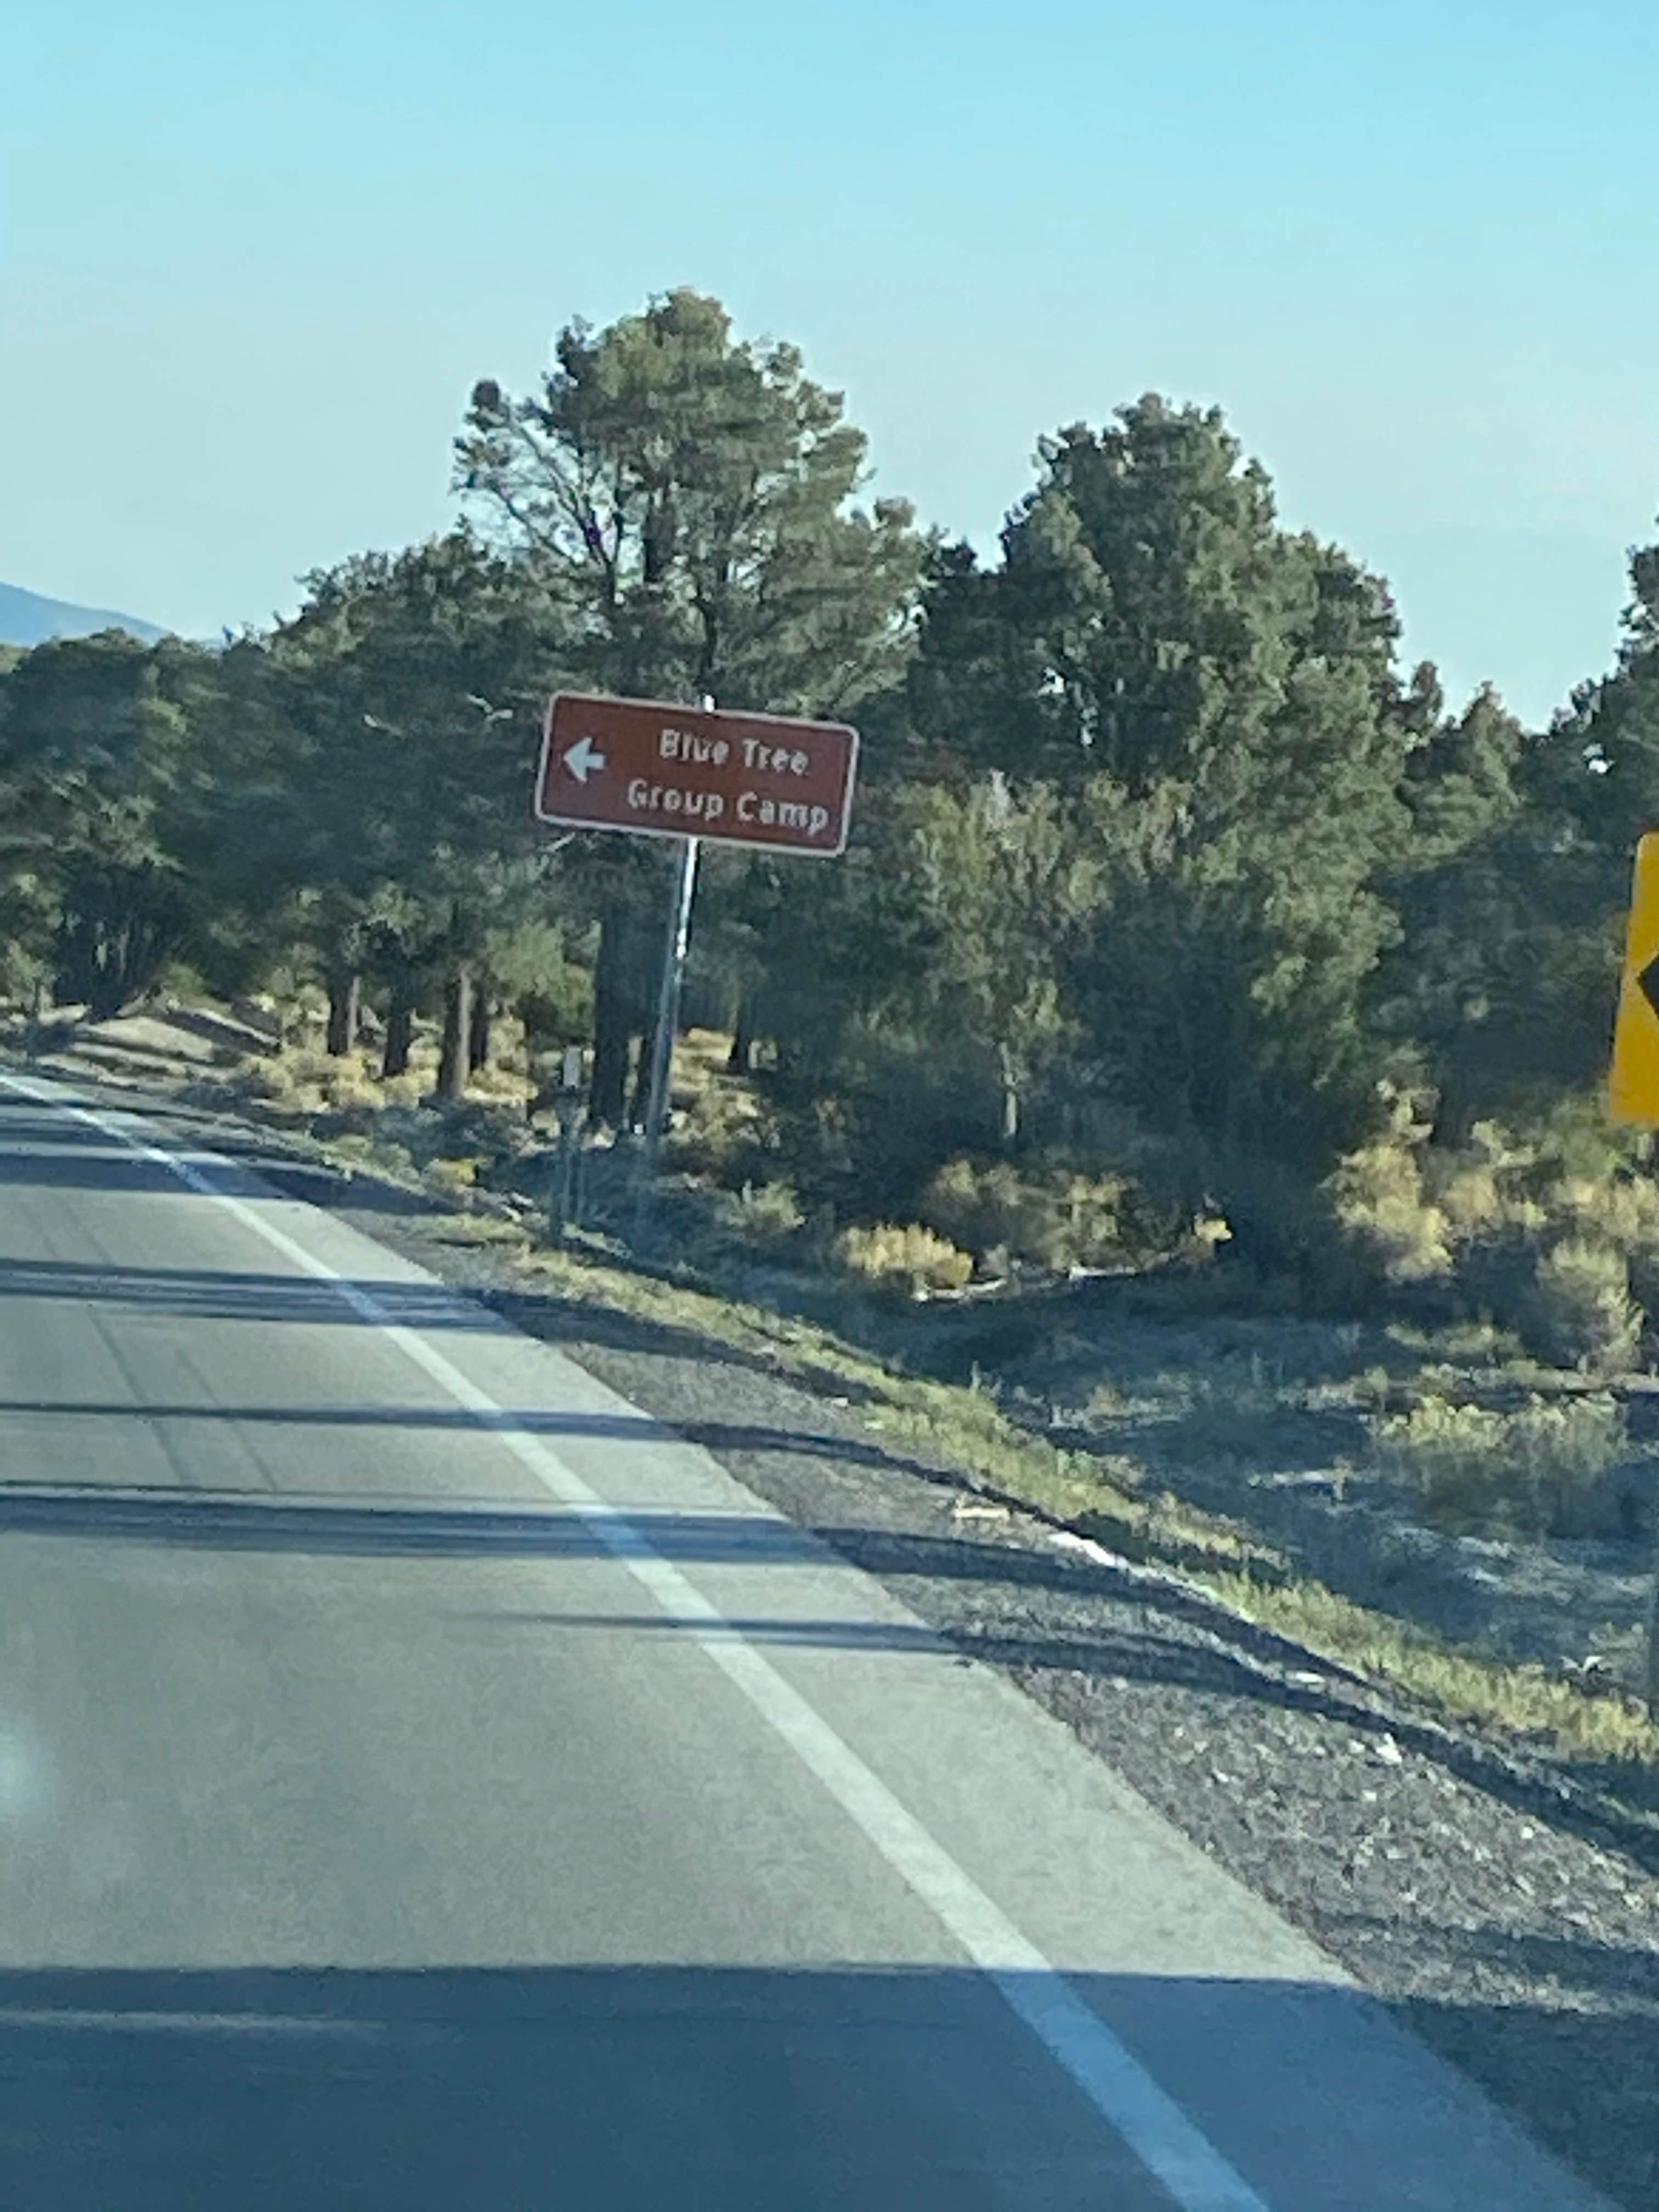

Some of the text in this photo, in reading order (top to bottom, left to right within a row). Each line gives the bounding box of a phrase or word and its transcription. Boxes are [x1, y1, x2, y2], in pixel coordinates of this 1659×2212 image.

[659, 729, 809, 776] Blue Tree
[627, 778, 829, 836] Group Camp
